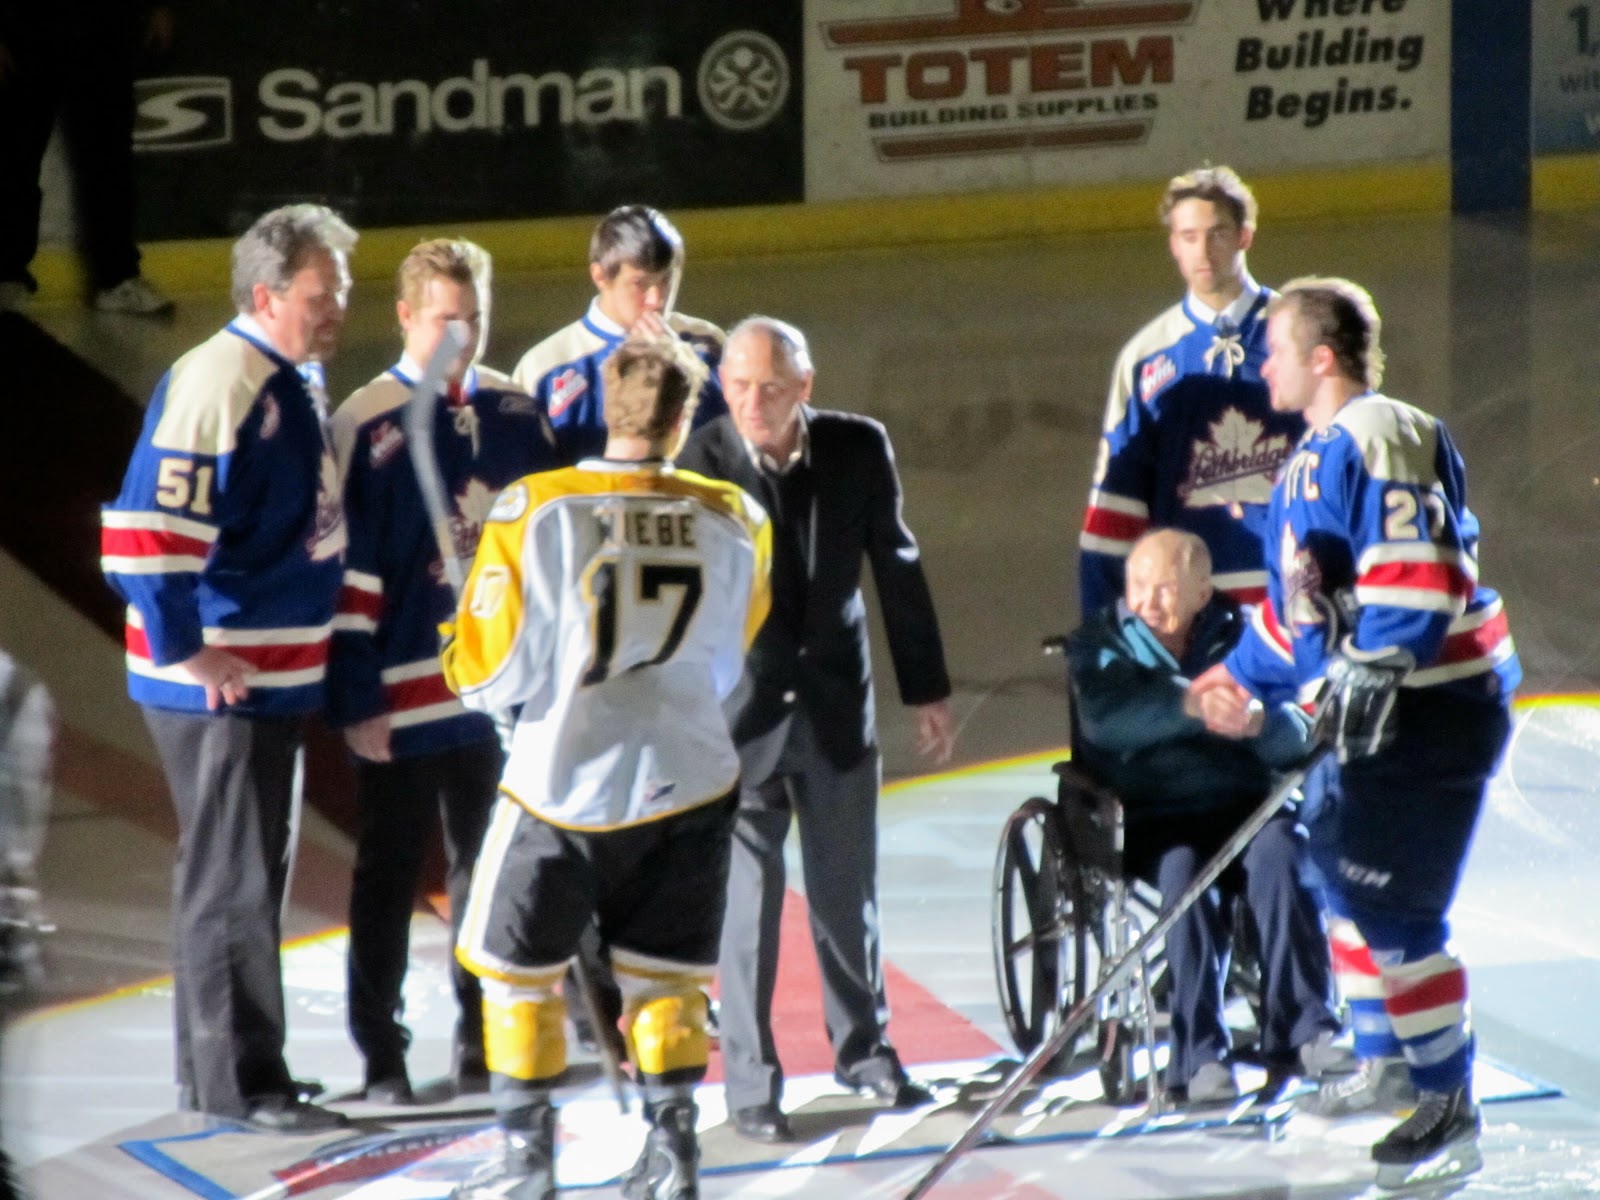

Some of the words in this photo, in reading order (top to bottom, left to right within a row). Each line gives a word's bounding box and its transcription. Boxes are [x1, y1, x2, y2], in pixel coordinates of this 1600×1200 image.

[843, 34, 1175, 105] TOTEM
[1235, 26, 1425, 73] Building
[257, 59, 682, 142] Sandman
[868, 102, 1008, 129] BUILDING
[1016, 93, 1160, 121] SUPPLIES
[1245, 76, 1413, 129] Begins.
[155, 456, 214, 515] 51
[580, 557, 705, 688] 17
